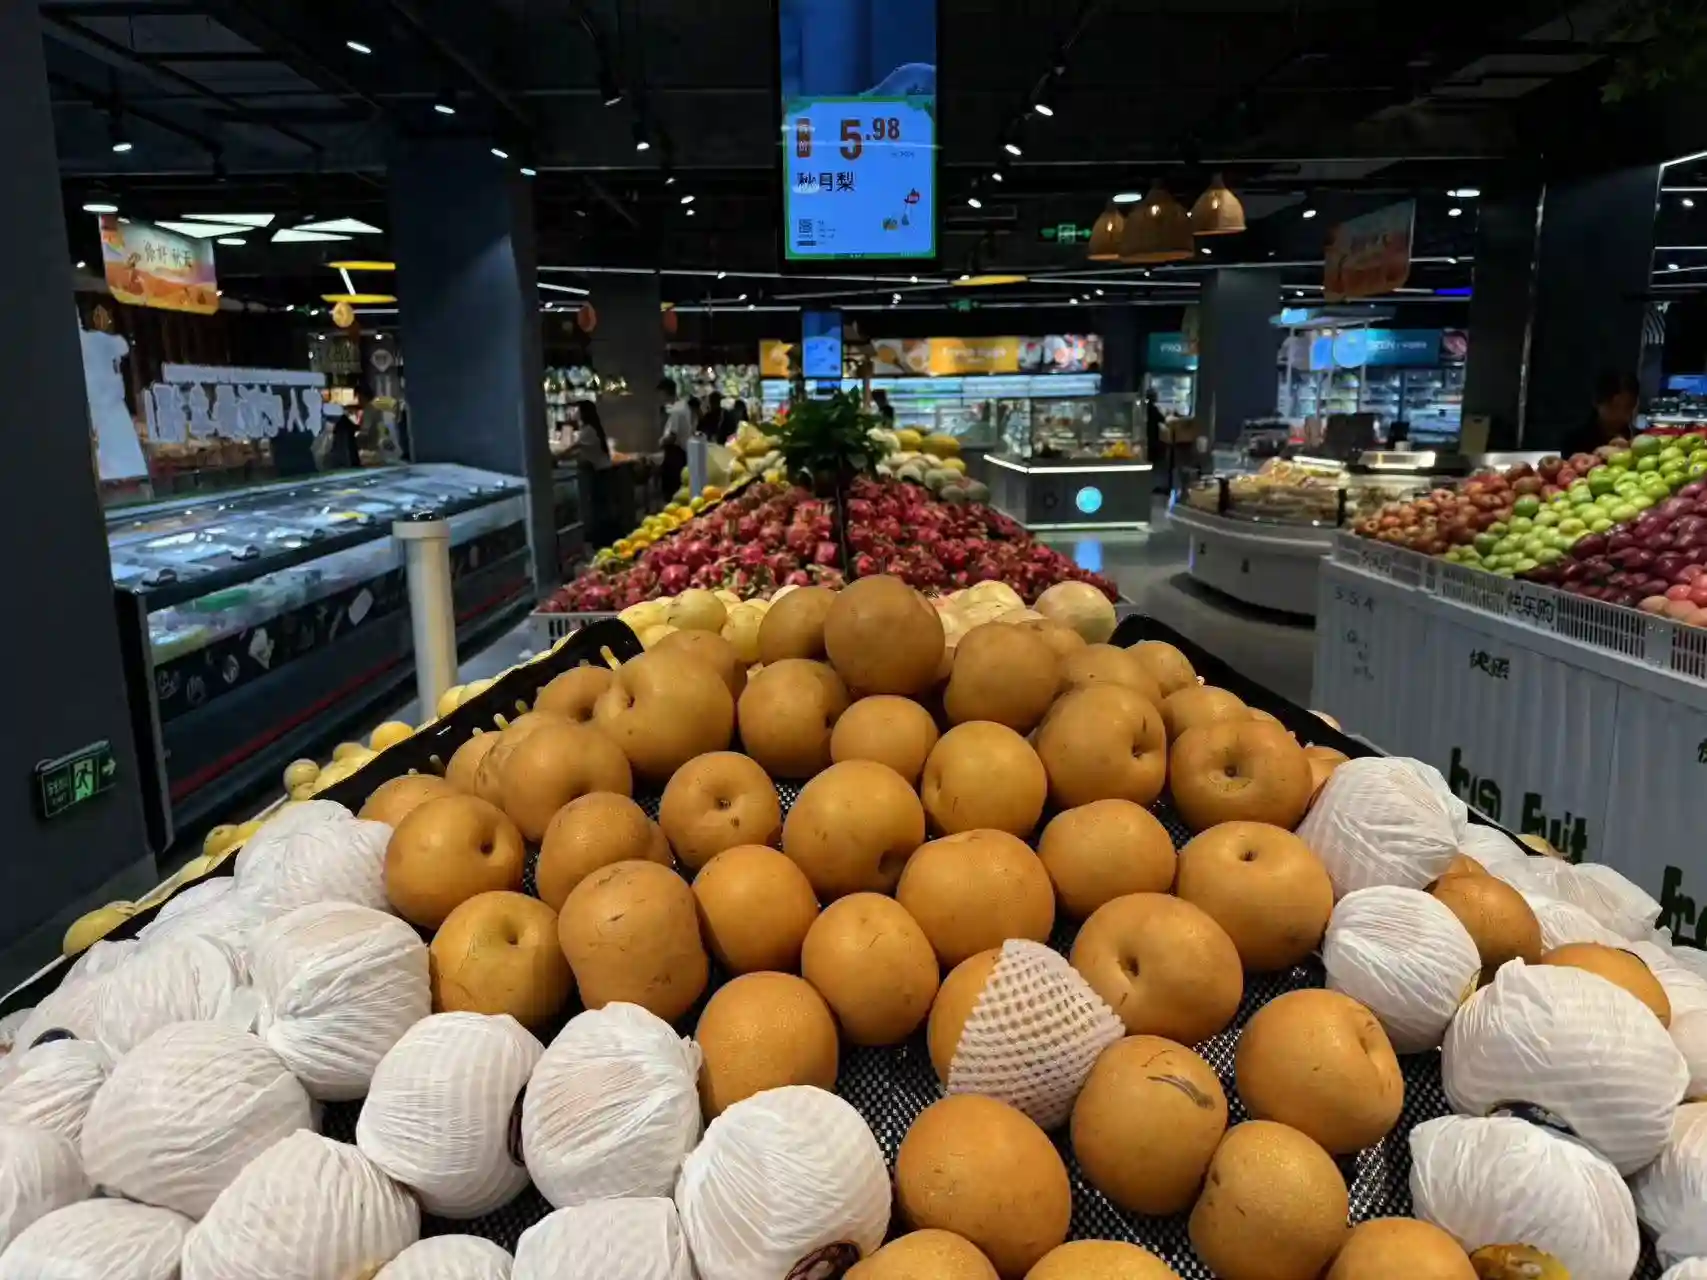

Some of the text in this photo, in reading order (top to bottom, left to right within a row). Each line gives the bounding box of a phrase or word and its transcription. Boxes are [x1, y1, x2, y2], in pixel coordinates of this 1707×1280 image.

[840, 117, 900, 160] 5.98
[797, 172, 855, 193] 秋月梨
